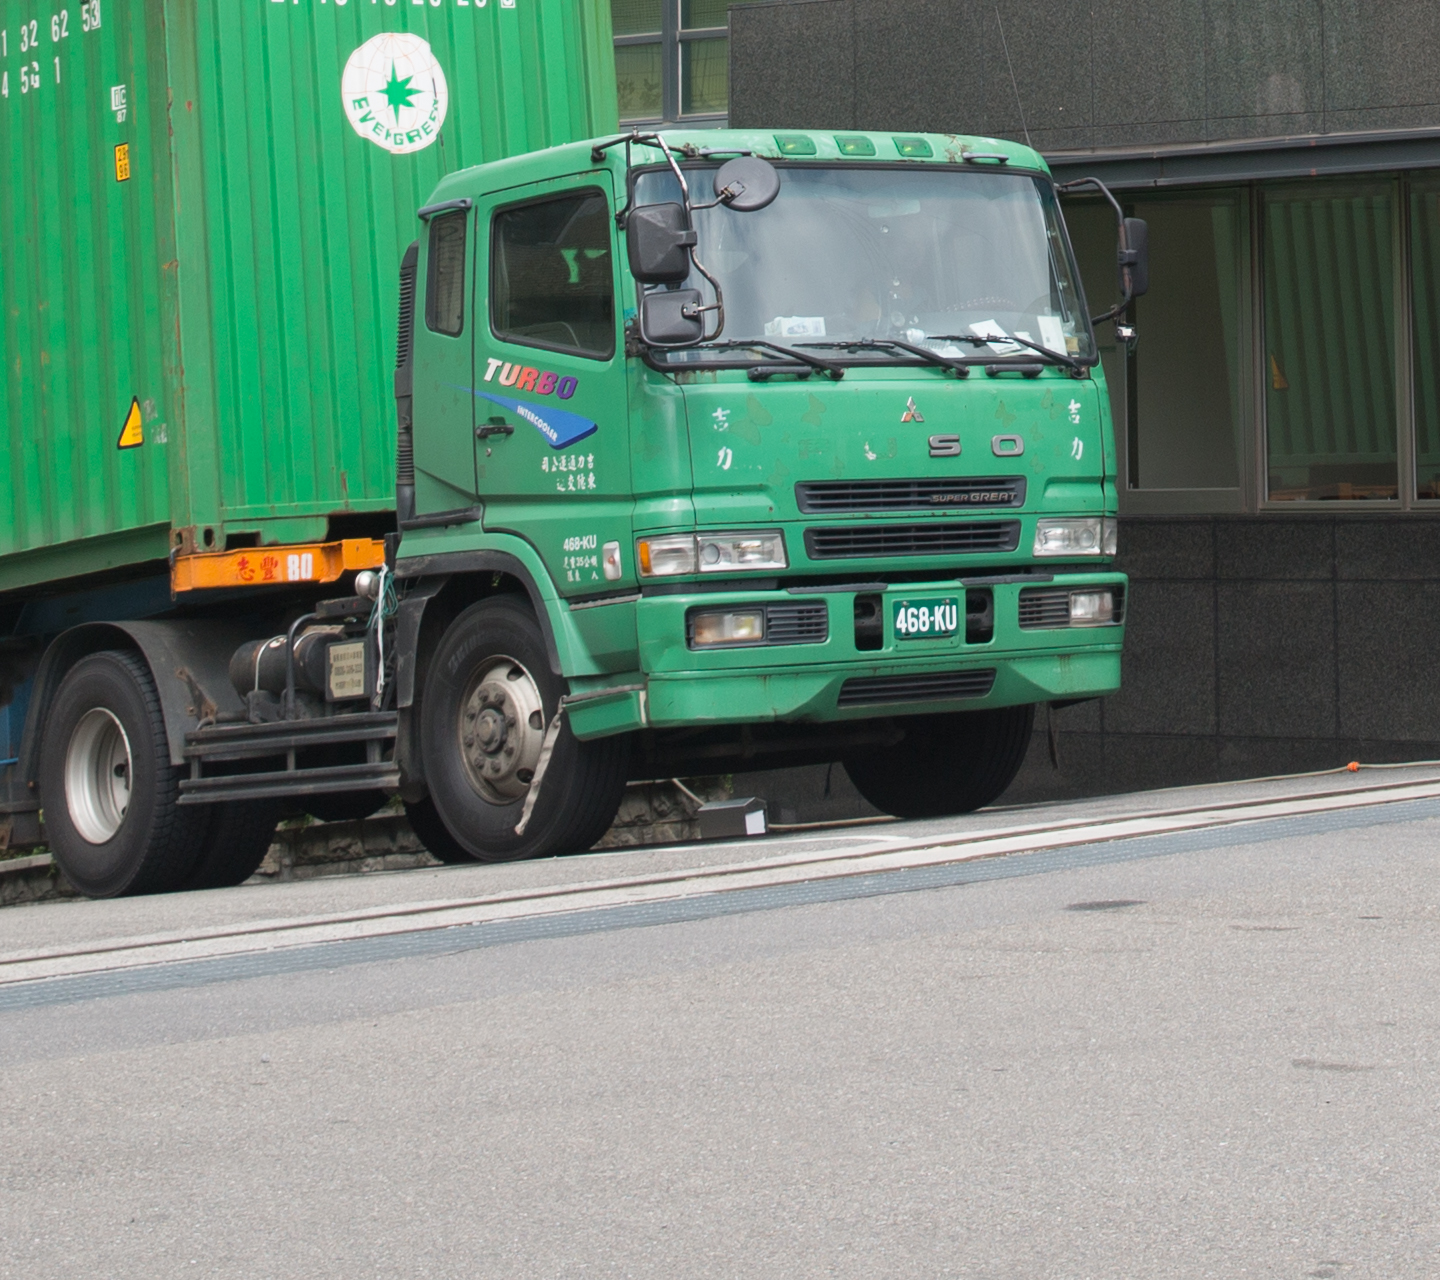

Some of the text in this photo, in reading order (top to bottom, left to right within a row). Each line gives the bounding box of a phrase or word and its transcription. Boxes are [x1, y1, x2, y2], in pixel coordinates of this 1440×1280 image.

[483, 357, 579, 401] TURBO
[516, 405, 558, 443] INTERCOOLER
[931, 491, 1018, 503] SUPER GREAT
[563, 535, 597, 552] 468-KU
[286, 552, 313, 581] 80
[895, 603, 957, 634] 468-KU
